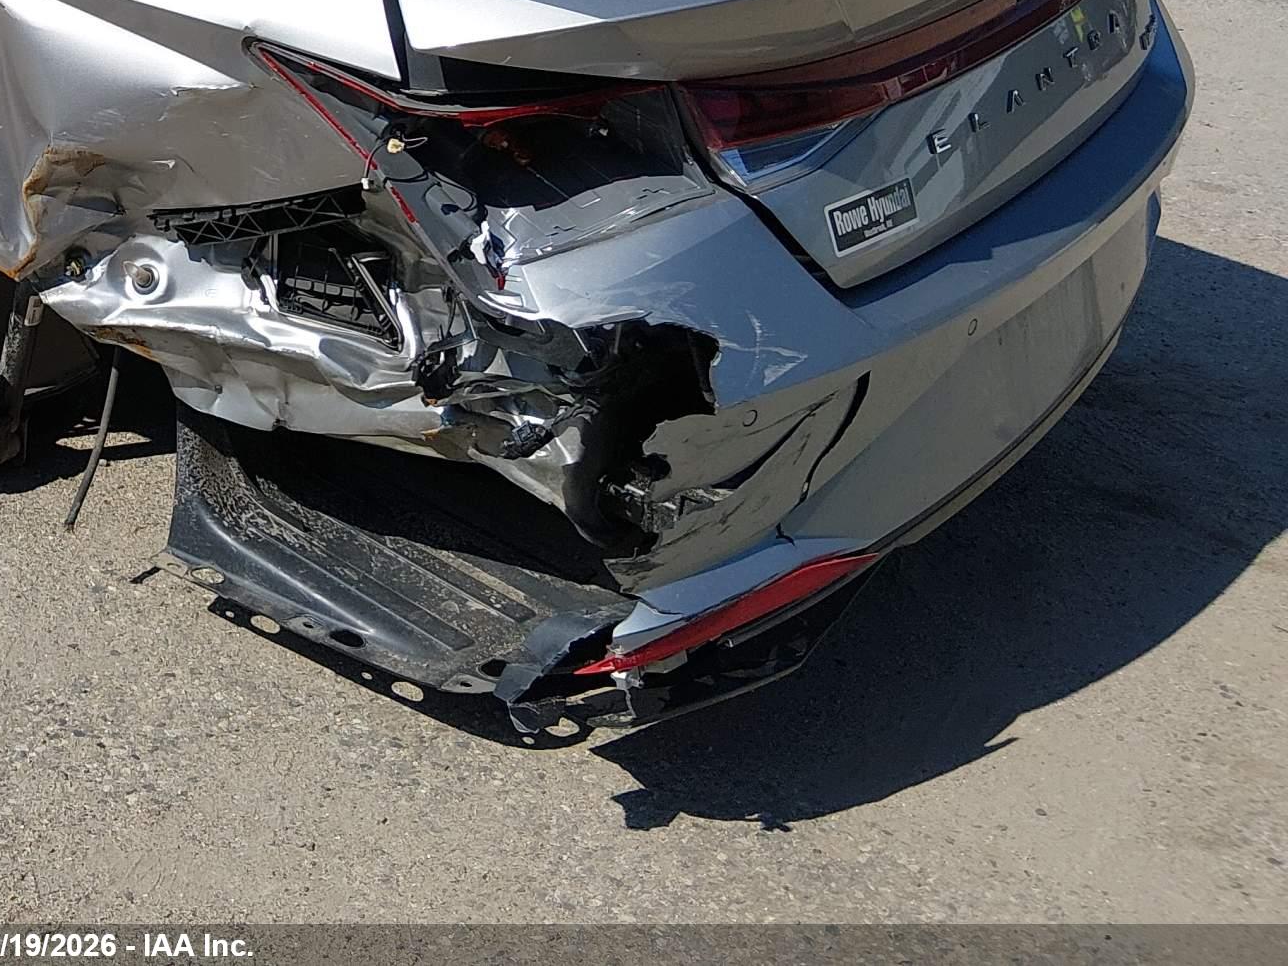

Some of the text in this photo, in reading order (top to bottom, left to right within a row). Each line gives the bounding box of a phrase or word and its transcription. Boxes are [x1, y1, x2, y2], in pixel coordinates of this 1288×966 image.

[926, 8, 1121, 156] ELANTRA
[833, 204, 869, 236] Rowe
[867, 182, 912, 223] Hyundai
